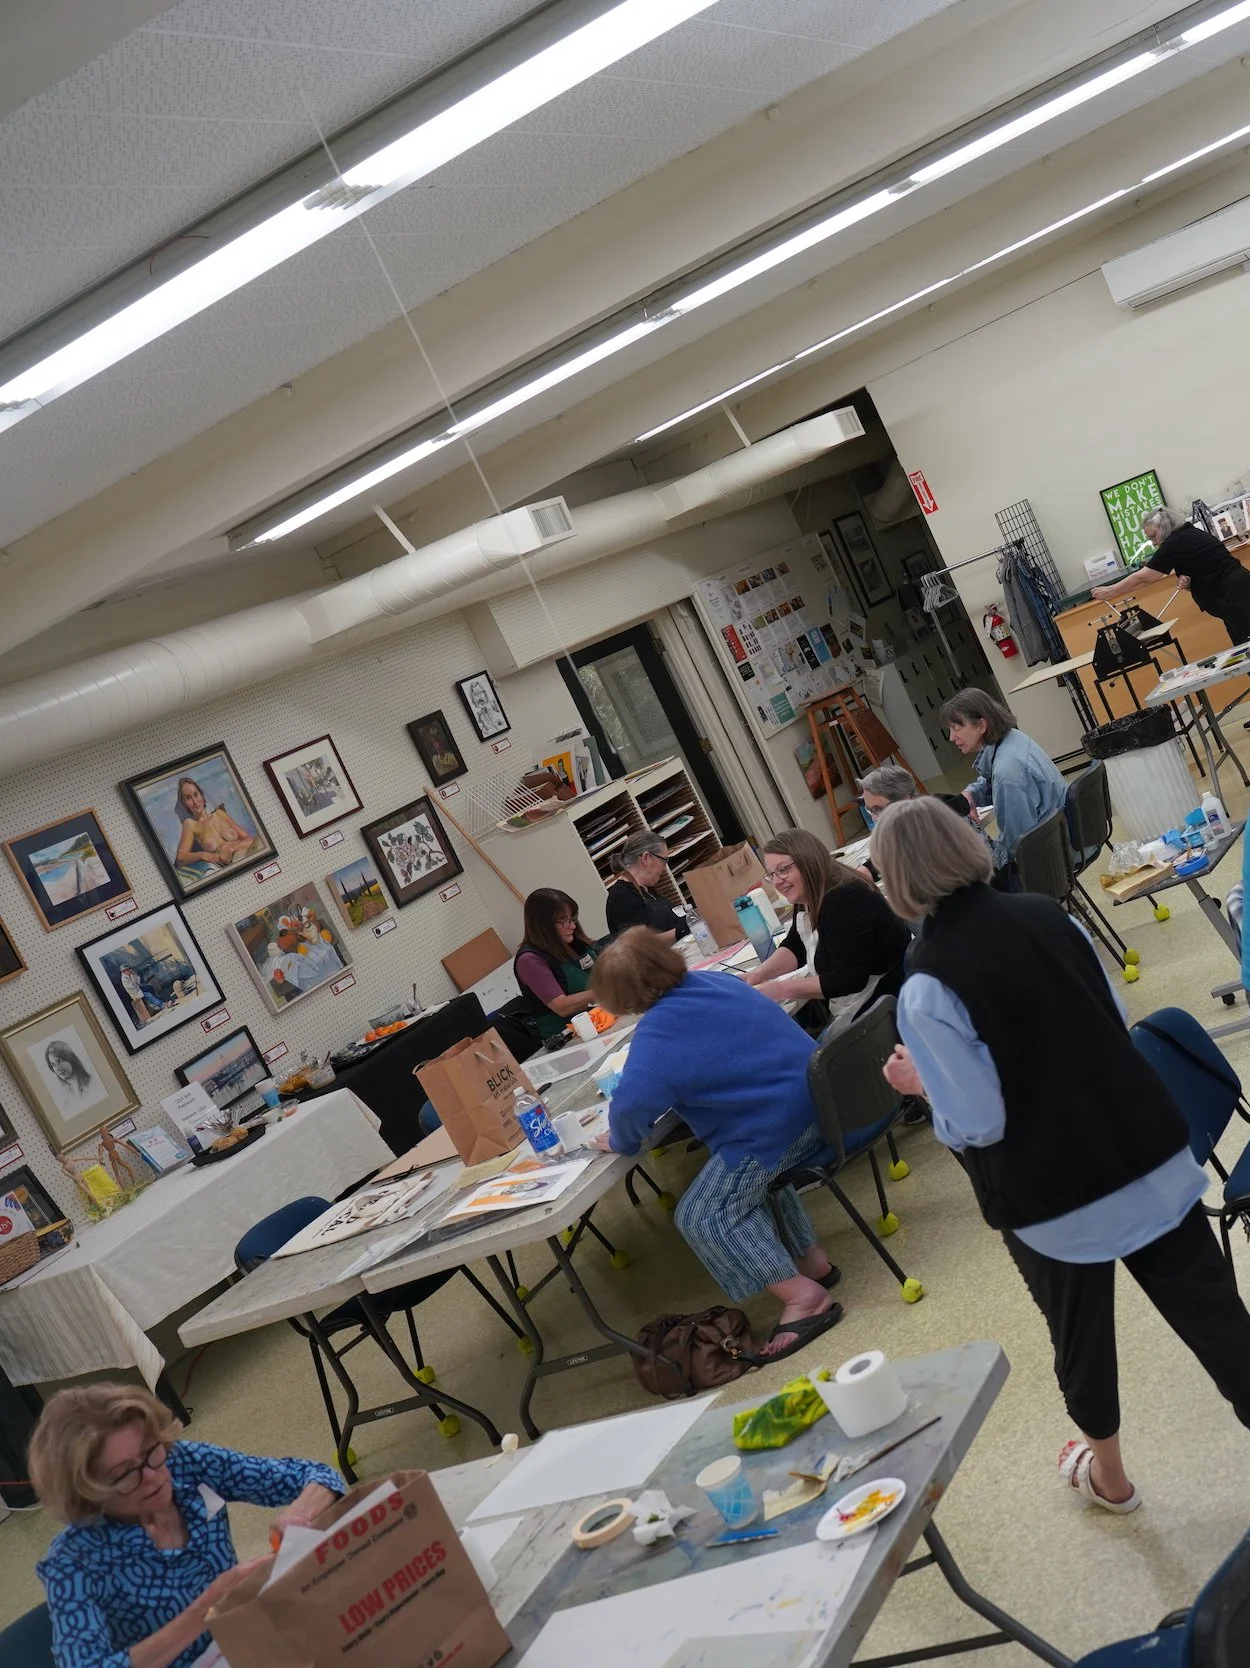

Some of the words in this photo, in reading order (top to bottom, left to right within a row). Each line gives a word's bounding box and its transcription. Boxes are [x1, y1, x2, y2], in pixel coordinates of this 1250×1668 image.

[1105, 489, 1120, 500] WE
[1124, 475, 1153, 493] DON'T
[1107, 483, 1159, 514] MAKE
[1111, 496, 1162, 522] MISTAKES
[486, 1064, 514, 1092] BLICK
[314, 1490, 405, 1566] FOODS
[338, 1588, 385, 1634] LOW
[382, 1540, 447, 1601] PRICES
